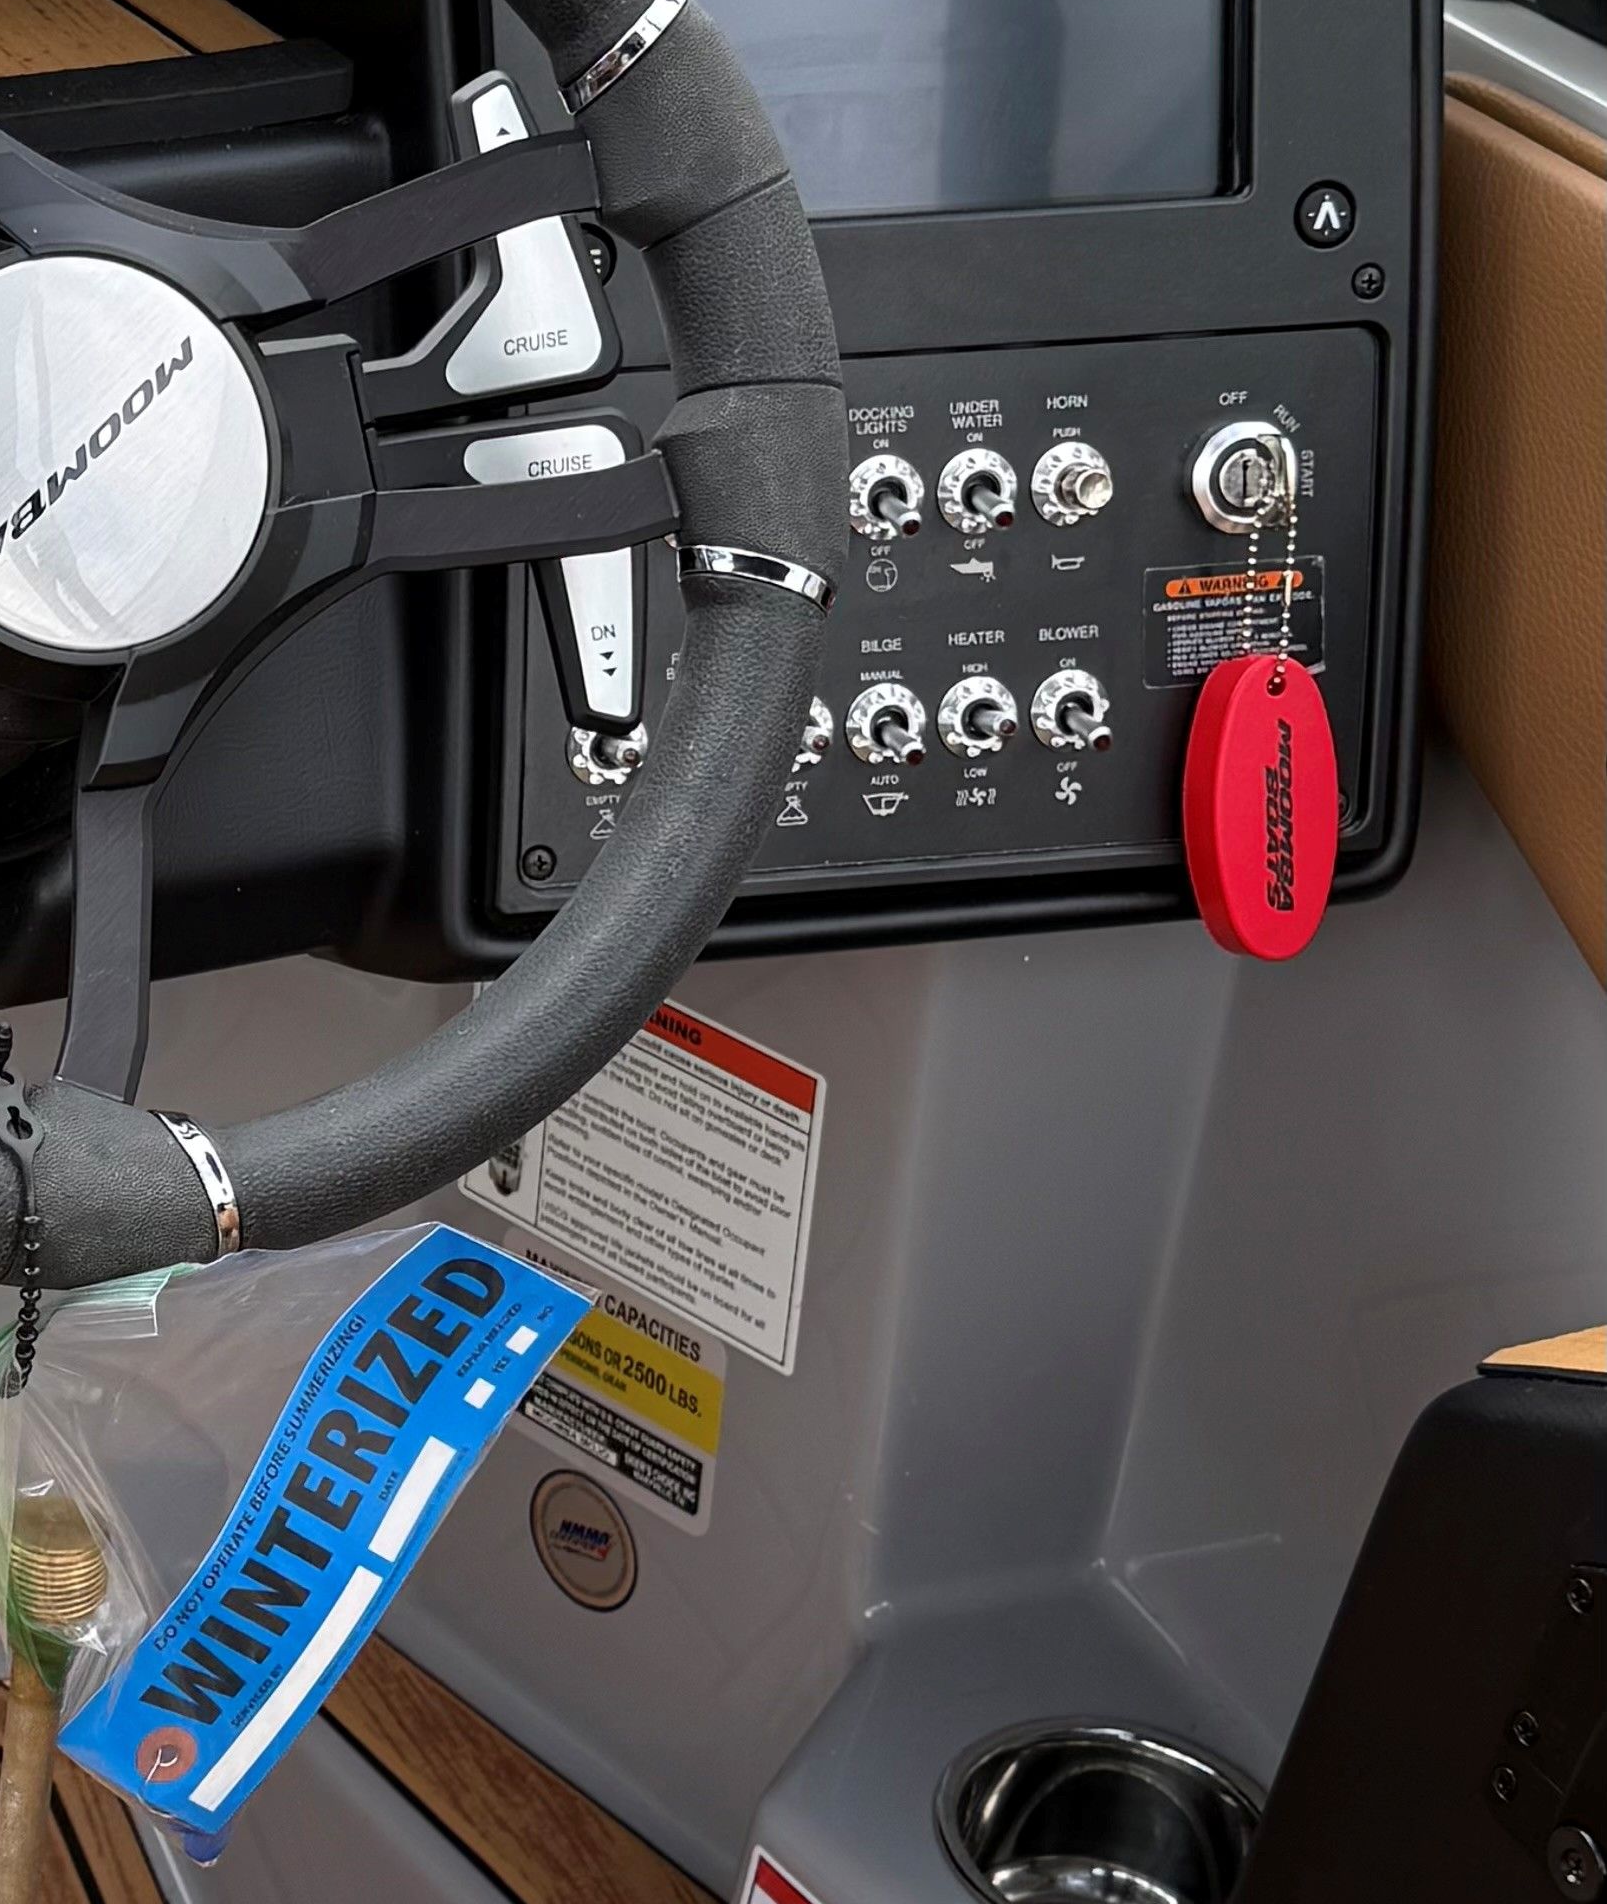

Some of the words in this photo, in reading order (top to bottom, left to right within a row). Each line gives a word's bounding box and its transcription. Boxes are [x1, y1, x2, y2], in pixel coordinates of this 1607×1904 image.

[504, 329, 568, 356] CRUISE
[1047, 395, 1088, 409] HORN
[1219, 390, 1248, 406] OFF
[848, 406, 915, 422] DOCKING
[949, 400, 999, 415] UNDER
[952, 414, 1003, 429] WATER
[1273, 404, 1301, 433] RUN
[856, 419, 907, 435] LIGHTS
[1053, 427, 1081, 438] PUSH
[872, 438, 889, 449] ON
[966, 432, 983, 443] ON
[528, 454, 593, 478] CRUISE
[1300, 449, 1314, 498] START
[870, 545, 892, 557] OFF
[963, 539, 986, 550] OFF
[591, 624, 616, 641] DN
[947, 628, 1005, 646] HEATER
[1038, 624, 1099, 642] BLOWER
[860, 637, 902, 653] BILGE
[961, 662, 988, 673] HIGH
[1059, 657, 1076, 668] ON
[860, 669, 903, 681] MANUAL
[963, 766, 988, 778] LOW
[1056, 761, 1078, 773] OFF
[870, 773, 900, 786] AUTO
[1277, 718, 1294, 912] MOOMBA
[1265, 764, 1281, 909] BOATS
[604, 1294, 701, 1364] CAPACITIES
[604, 1347, 621, 1372] OR
[623, 1354, 667, 1396] 2500
[668, 1383, 702, 1418] LBS.
[153, 1624, 178, 1652] DO
[174, 1591, 205, 1627] NOT
[201, 1510, 256, 1590] OPERATE
[250, 1441, 292, 1512] BEFORE
[283, 1313, 368, 1442] SUMMERIZING!
[379, 1470, 400, 1502] DATE
[138, 1257, 507, 1726] WINTERIZED
